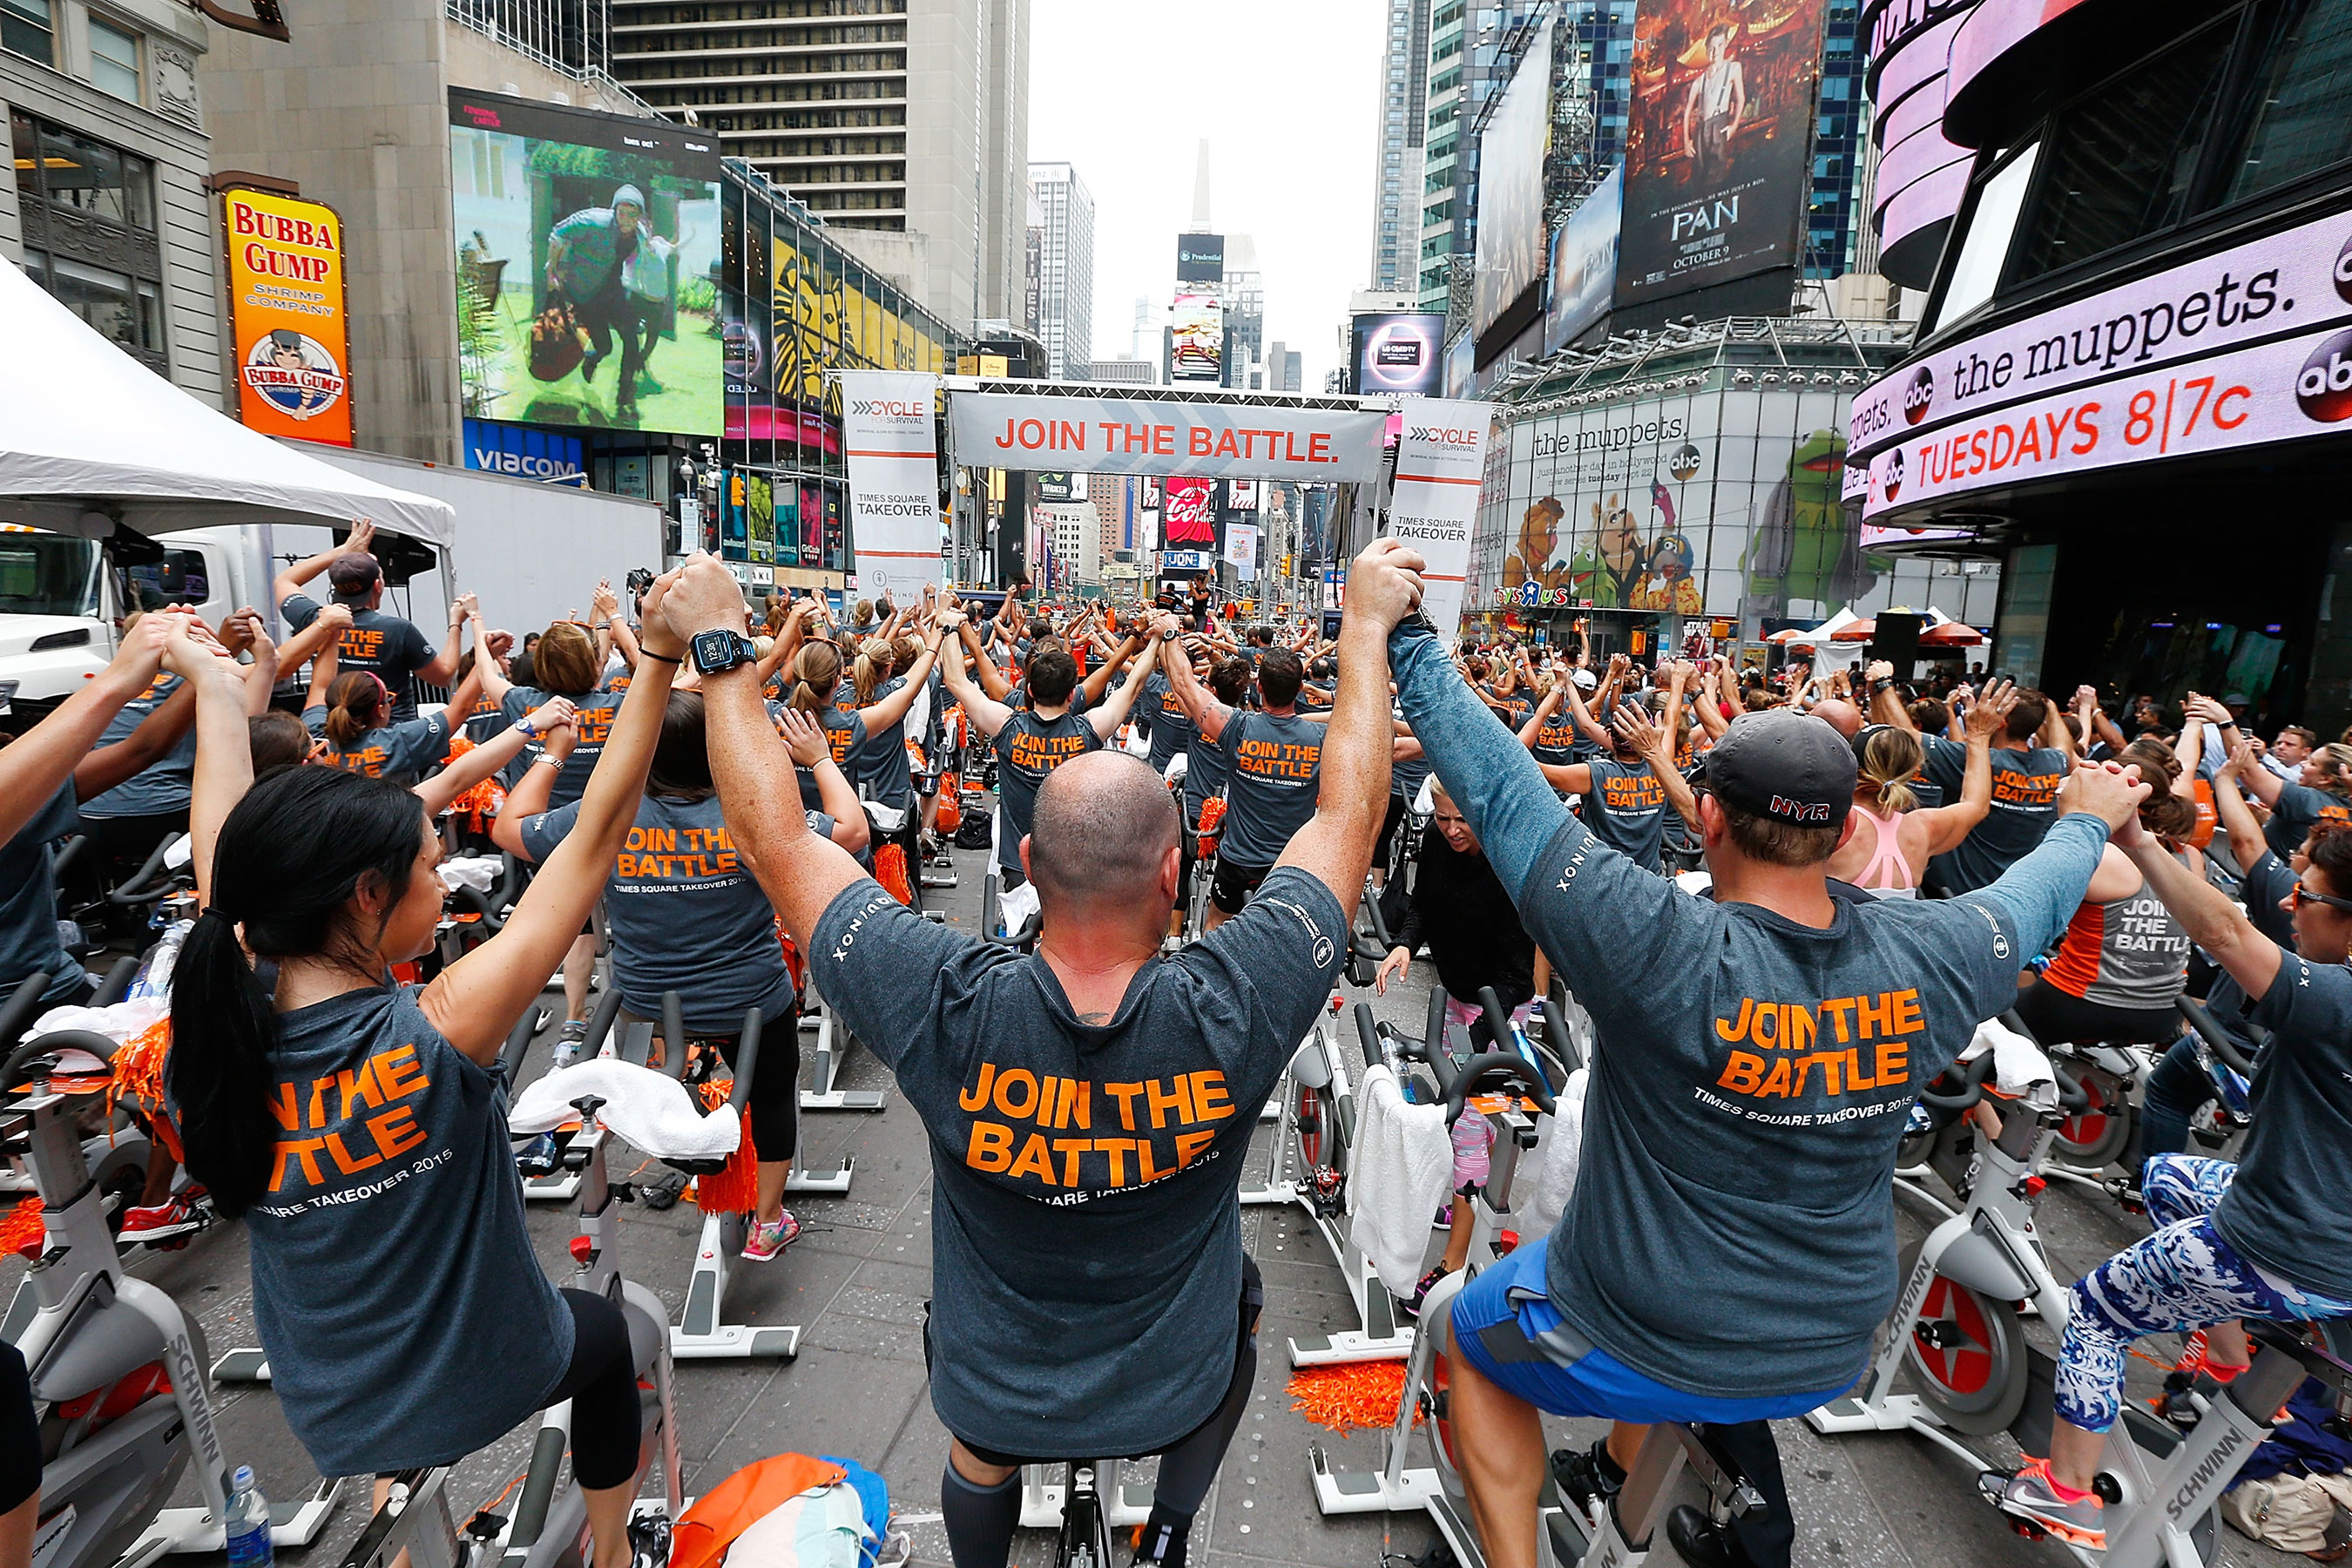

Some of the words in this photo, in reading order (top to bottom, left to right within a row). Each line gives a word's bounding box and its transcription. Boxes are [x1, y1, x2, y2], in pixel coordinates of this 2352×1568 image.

[233, 201, 335, 251] BUBBA
[1670, 195, 1740, 242] PAN
[245, 241, 329, 283] GUMP
[1191, 253, 1222, 262] Prudential
[1673, 248, 1722, 270] OCTOBER
[1722, 245, 1731, 258] 9
[254, 283, 324, 302] SHRIMP
[246, 295, 335, 317] COMPANY
[1953, 352, 2014, 402] the
[2023, 267, 2295, 372] muppets.
[247, 368, 298, 384] BUBBA
[301, 371, 342, 392] GUMP
[2297, 351, 2352, 398] ab
[1905, 381, 1933, 410] abc
[871, 400, 923, 417] CYCLE
[886, 416, 924, 425] SURVIVAL
[995, 417, 1085, 451] JOIN
[1098, 422, 1175, 455] THE
[1189, 427, 1339, 463] BATTLE.
[1427, 427, 1478, 446] CYCLE
[1441, 443, 1477, 453] SURVIVAL
[1534, 432, 1570, 457] the
[1573, 416, 1688, 451] muppets.
[1917, 402, 2102, 489] TUESDAYS
[1589, 460, 1606, 474] day
[1608, 459, 1618, 470] in
[1619, 452, 1667, 471] hollywood
[1669, 454, 1700, 470] abc
[1588, 471, 1621, 485] tuesday
[1641, 467, 1653, 477] 22
[1884, 461, 1904, 487] abc
[857, 503, 932, 517] TAKEOVER
[858, 493, 886, 503] TIMES
[887, 494, 928, 504] SQUARE
[1395, 525, 1466, 541] TAKEOVER
[1397, 516, 1426, 526] TIMES
[1427, 518, 1464, 529] SQUARE
[348, 628, 384, 644] THE
[337, 642, 377, 658] TTLE
[573, 707, 615, 726] THE
[827, 729, 853, 746] HE
[1011, 731, 1047, 754] JOIN
[1050, 734, 1085, 754] THE
[1538, 733, 1575, 747] BATTLE
[348, 746, 387, 768] THE
[1237, 739, 1279, 759] JOIN
[1282, 743, 1321, 762] THE
[1239, 755, 1313, 778] BATTLE
[1251, 774, 1274, 785] SQUARE
[1274, 779, 1302, 787] TAKEOVER
[1603, 775, 1639, 792] JOIN
[1993, 769, 2031, 788] JOIN
[2027, 773, 2060, 790] THE
[1605, 789, 1666, 808] BATTLE
[1993, 784, 2055, 804] BATTLE
[1769, 794, 1830, 821] NYR
[624, 827, 677, 852] OIN
[617, 852, 740, 878] BATTLE
[614, 883, 640, 895] TIMES
[640, 884, 679, 894] SQUARE
[680, 880, 727, 892] TAKEOVER
[2121, 916, 2168, 935] THE
[1714, 997, 1822, 1051] JOIN
[1821, 987, 1926, 1044] THE
[1715, 1041, 1910, 1099] BATTLE
[958, 1061, 1092, 1130] JOIN
[1104, 1069, 1236, 1132] THE
[1693, 1086, 1743, 1115] TIMES
[1745, 1110, 1813, 1127] SQUARE
[1815, 1104, 1884, 1125] TAKEOVER
[1885, 1095, 1915, 1113] 2015
[267, 1105, 429, 1193] TTLE
[965, 1119, 1216, 1188] BATTLE
[262, 1202, 308, 1219] UARE
[307, 1168, 410, 1208] TAKEOVER
[412, 1148, 454, 1175] 2015
[1882, 1254, 1932, 1361] SCHWINN
[174, 1333, 220, 1466] SCHWINN
[2166, 1427, 2244, 1522] SCHWINN
